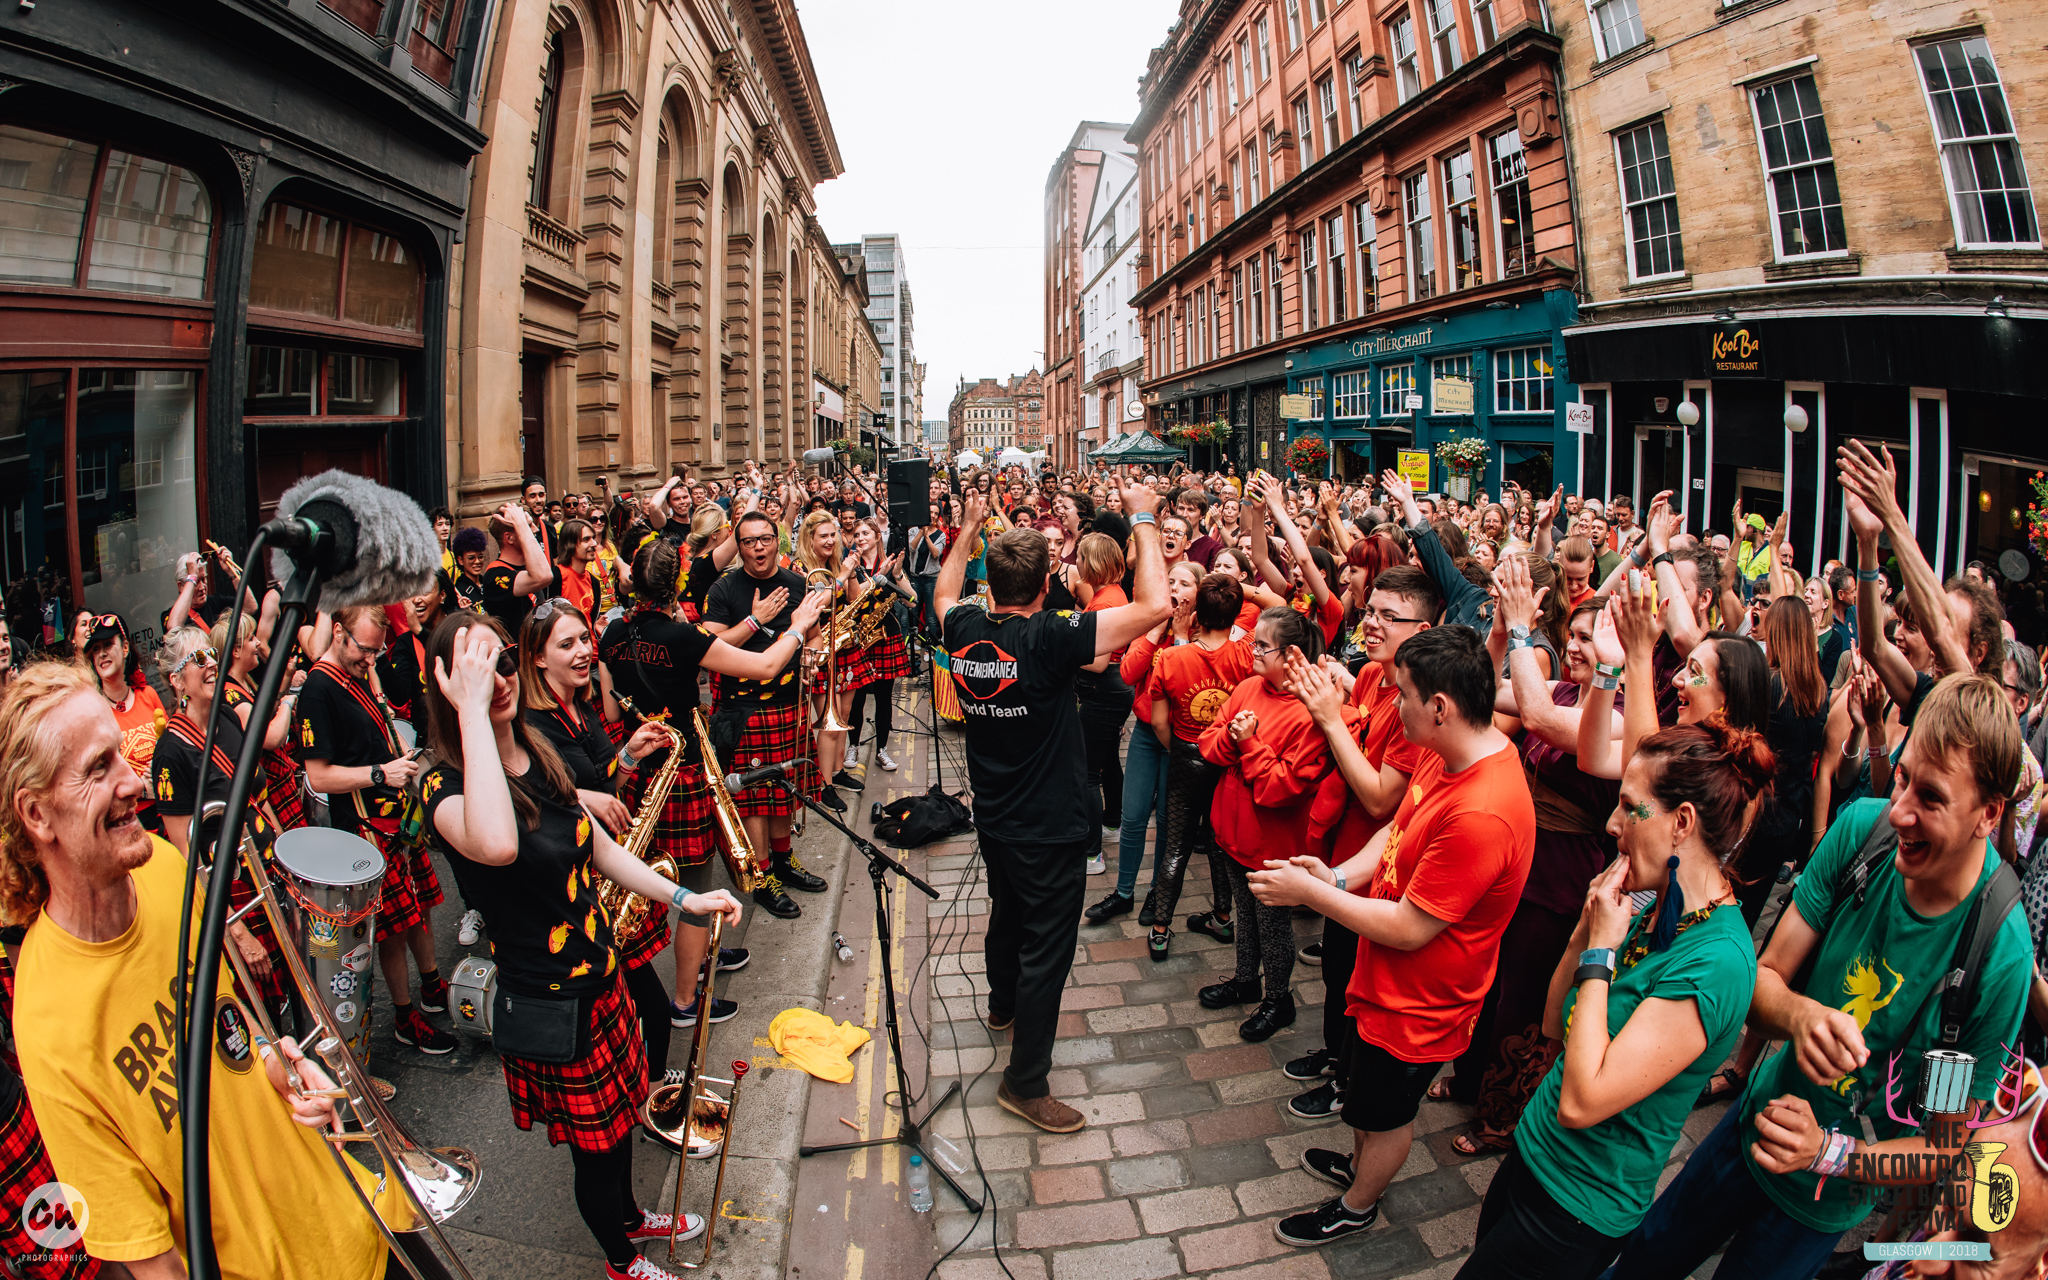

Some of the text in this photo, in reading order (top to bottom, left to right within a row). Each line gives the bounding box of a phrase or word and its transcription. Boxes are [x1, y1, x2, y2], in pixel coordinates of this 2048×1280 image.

[1712, 328, 1759, 360] Kool Ba
[1716, 361, 1758, 371] RESTAURANT
[1693, 480, 1704, 488] 109
[141, 627, 153, 641] TO
[987, 704, 1028, 718] Team
